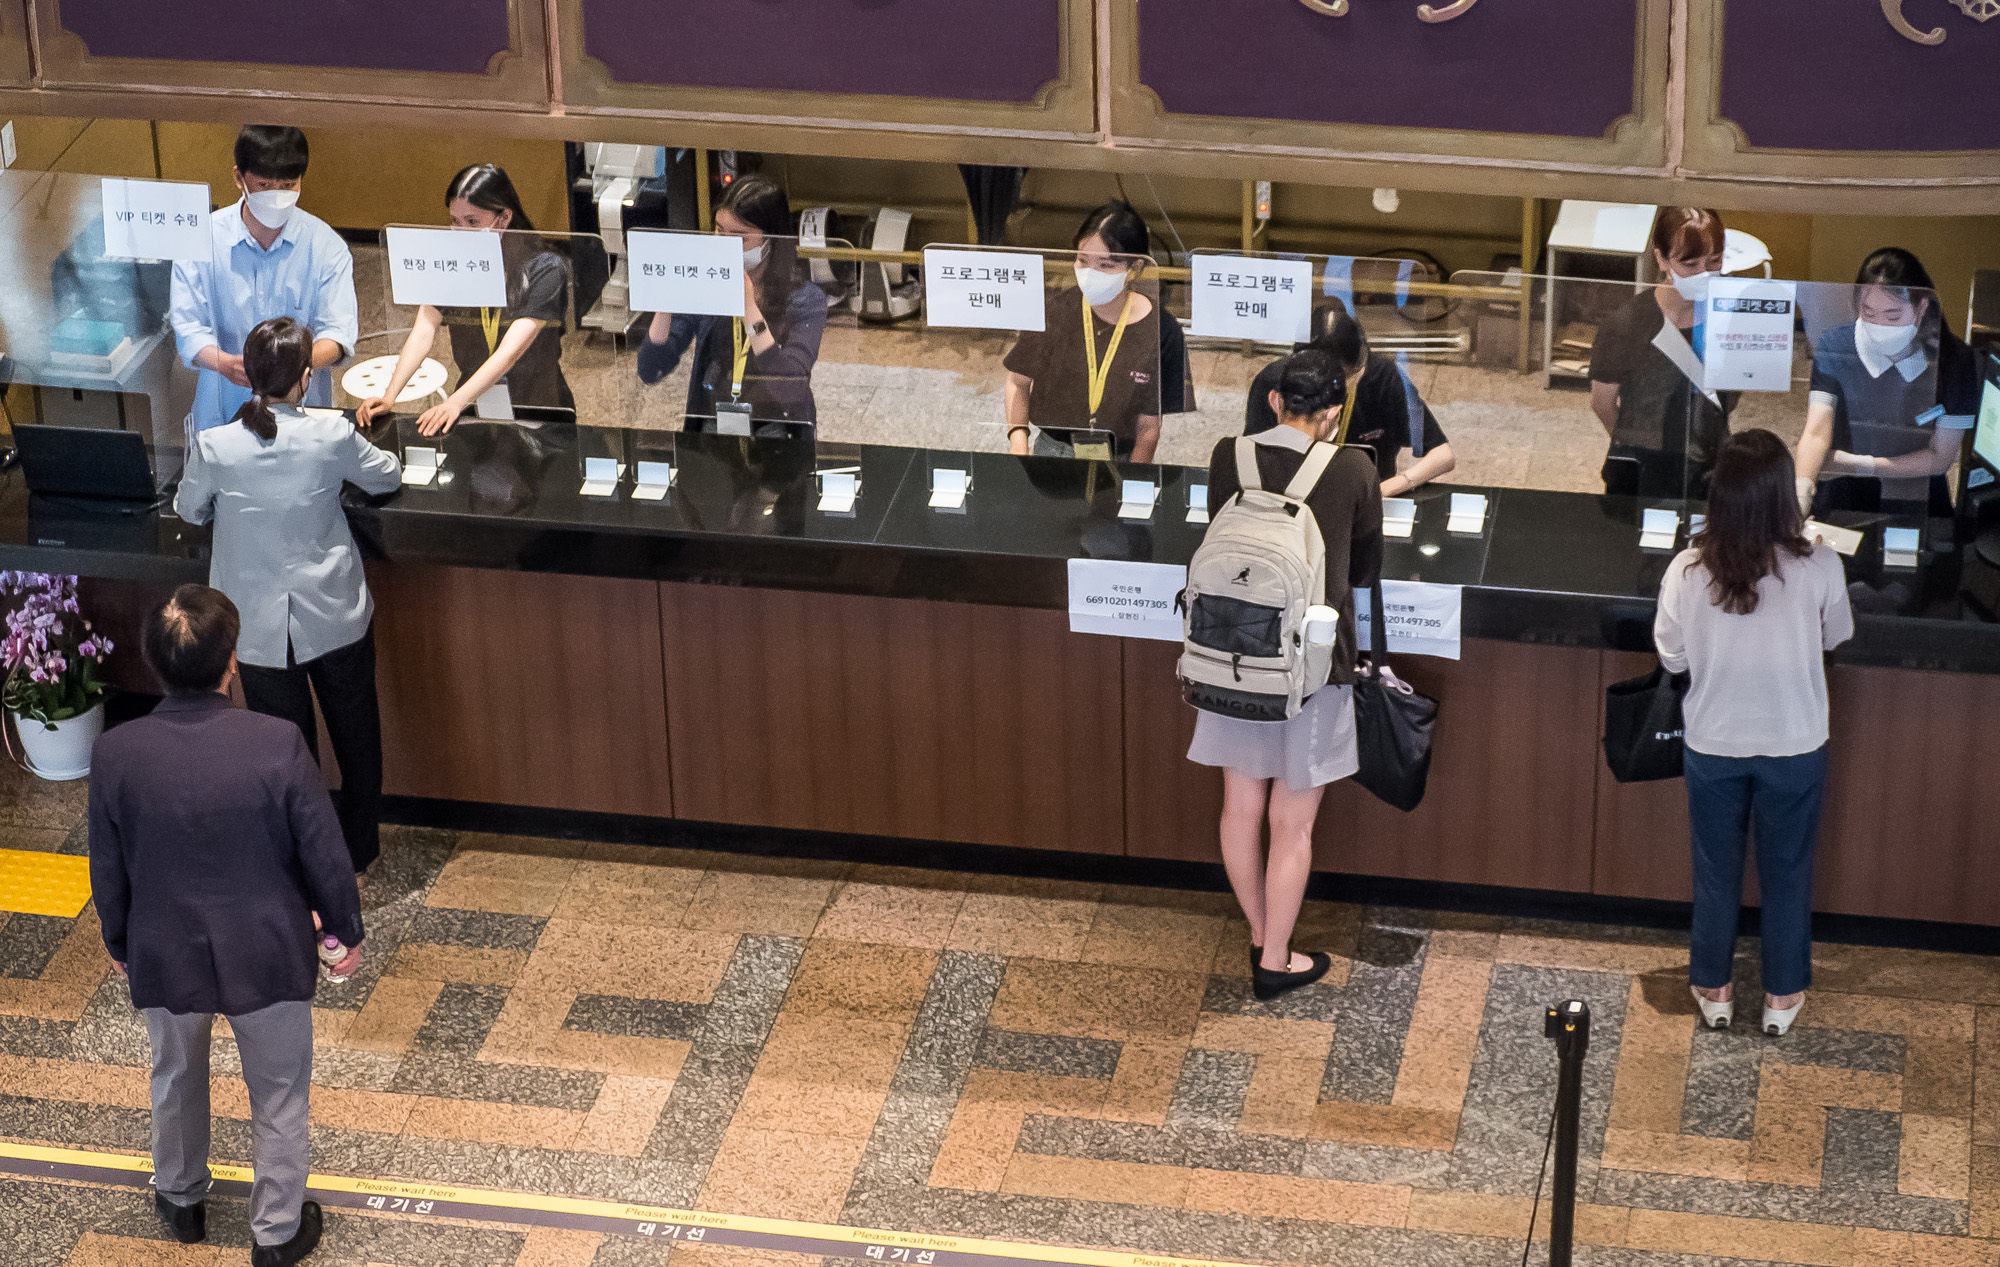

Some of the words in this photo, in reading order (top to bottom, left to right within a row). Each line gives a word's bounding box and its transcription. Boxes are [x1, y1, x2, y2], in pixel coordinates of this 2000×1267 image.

[115, 211, 135, 222] VIP
[141, 211, 166, 226] 티켓
[174, 213, 198, 227] 수령
[402, 258, 426, 271] 현장
[434, 260, 458, 272] 티켓
[466, 260, 490, 272] 수령
[642, 263, 666, 276] 현장
[674, 265, 698, 278] 티켓
[706, 266, 730, 280] 수령
[941, 266, 1027, 285] 프로그램북
[1207, 272, 1295, 293] 프로그램북
[968, 292, 1002, 308] 판매
[1234, 301, 1268, 319] 판매
[1112, 584, 1142, 594] 국민은행
[1085, 595, 1168, 609] 66910201497305
[1191, 690, 1270, 714] KANGOL
[211, 1166, 237, 1178] here
[356, 1181, 397, 1193] Please
[401, 1187, 426, 1196] wait
[428, 1188, 456, 1199] here
[366, 1196, 434, 1214] 대기선
[625, 1207, 667, 1219] Please
[671, 1213, 697, 1222] wait
[699, 1215, 728, 1225] here
[637, 1222, 706, 1241] 대기선
[852, 1230, 895, 1242] Please
[899, 1236, 925, 1245] wait
[928, 1238, 957, 1248] here
[865, 1245, 936, 1264] 대기선
